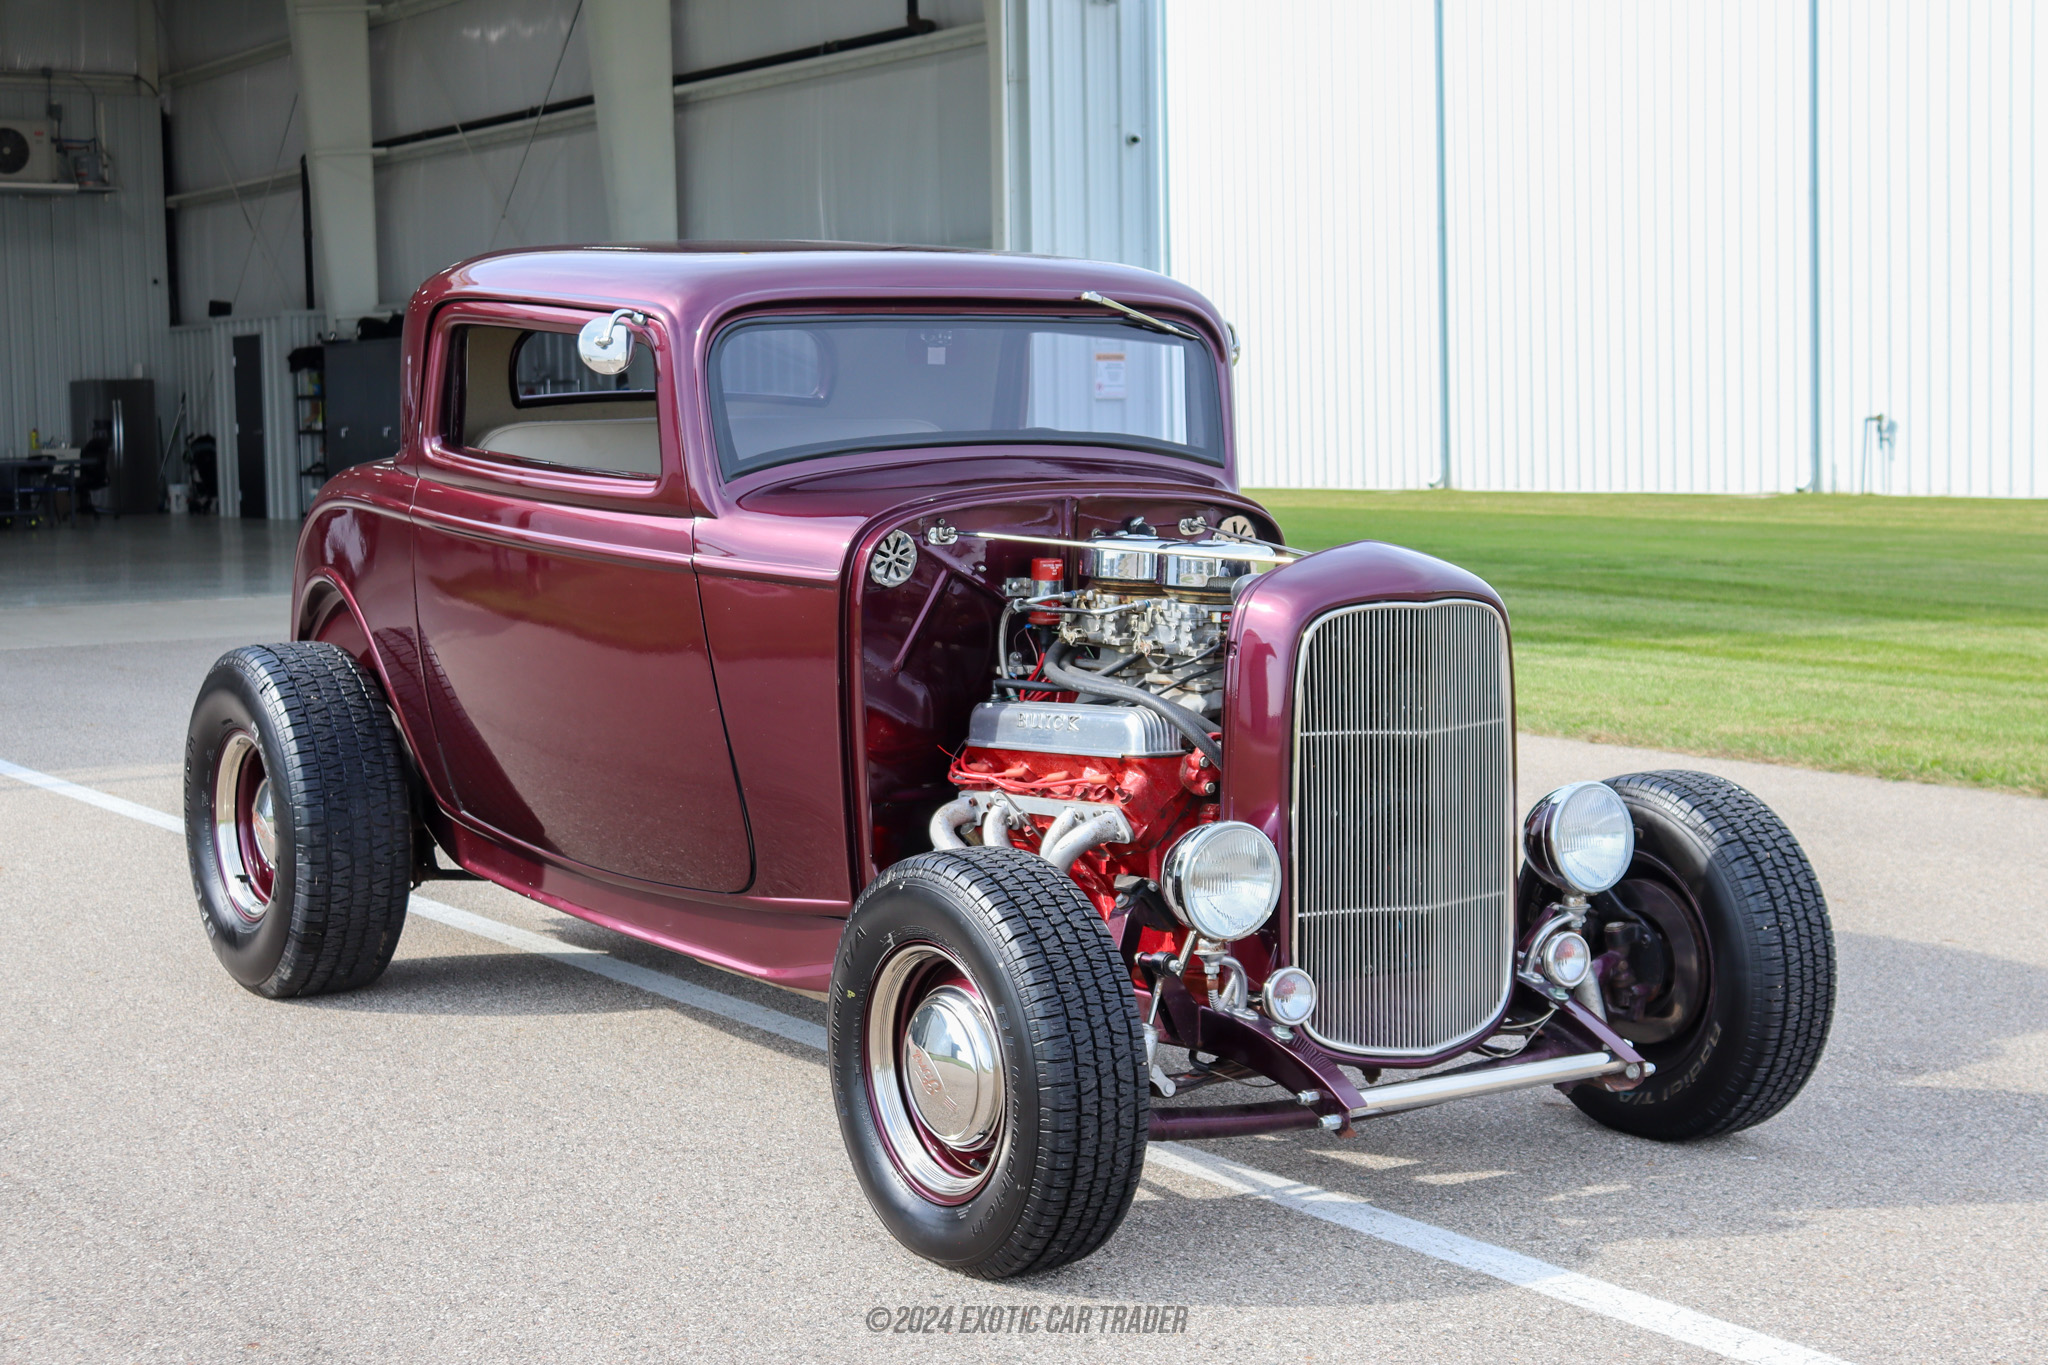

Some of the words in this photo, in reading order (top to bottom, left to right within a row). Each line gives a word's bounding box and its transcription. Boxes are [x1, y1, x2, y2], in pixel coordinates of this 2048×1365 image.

[1017, 712, 1081, 732] BUICK
[911, 1048, 943, 1096] Ford
[1662, 1022, 1722, 1101] Radial
[1618, 1091, 1656, 1106] T/A
